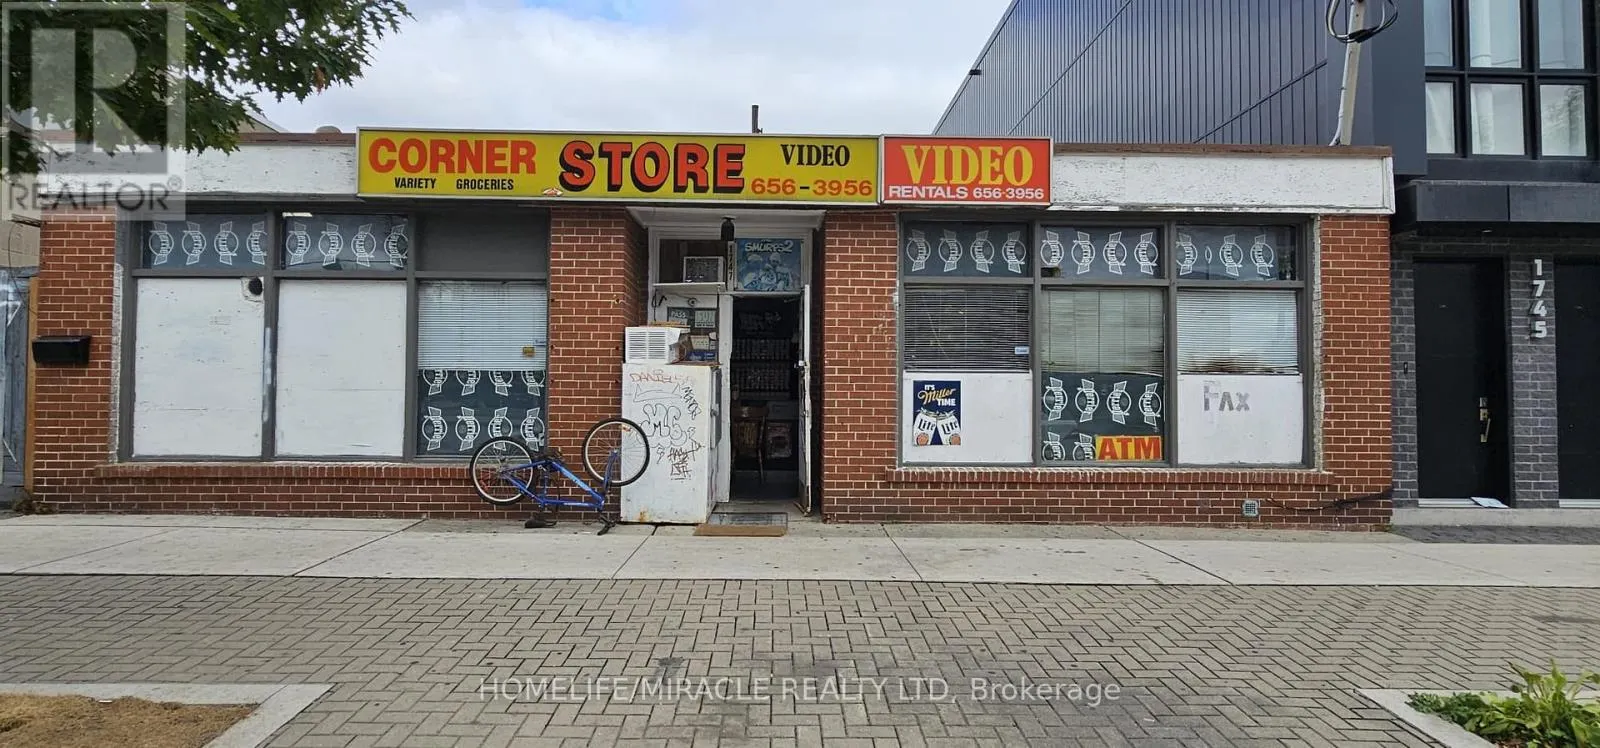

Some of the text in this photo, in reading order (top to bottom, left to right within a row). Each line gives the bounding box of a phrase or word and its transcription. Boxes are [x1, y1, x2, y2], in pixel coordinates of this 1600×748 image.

[780, 143, 851, 167] VIDEO
[368, 137, 746, 195] CORNER STORE
[900, 144, 1034, 186] VIDEO
[394, 177, 515, 191] VARIETY GROCERIES
[751, 178, 873, 197] 656-3956
[888, 185, 1045, 201] RENTALS 656-3956
[1532, 258, 1548, 338] 1745
[917, 388, 957, 405] Miller
[937, 398, 956, 406] TIME
[918, 418, 936, 431] Lite
[941, 420, 958, 435] Lite
[1098, 437, 1161, 461] ATM
